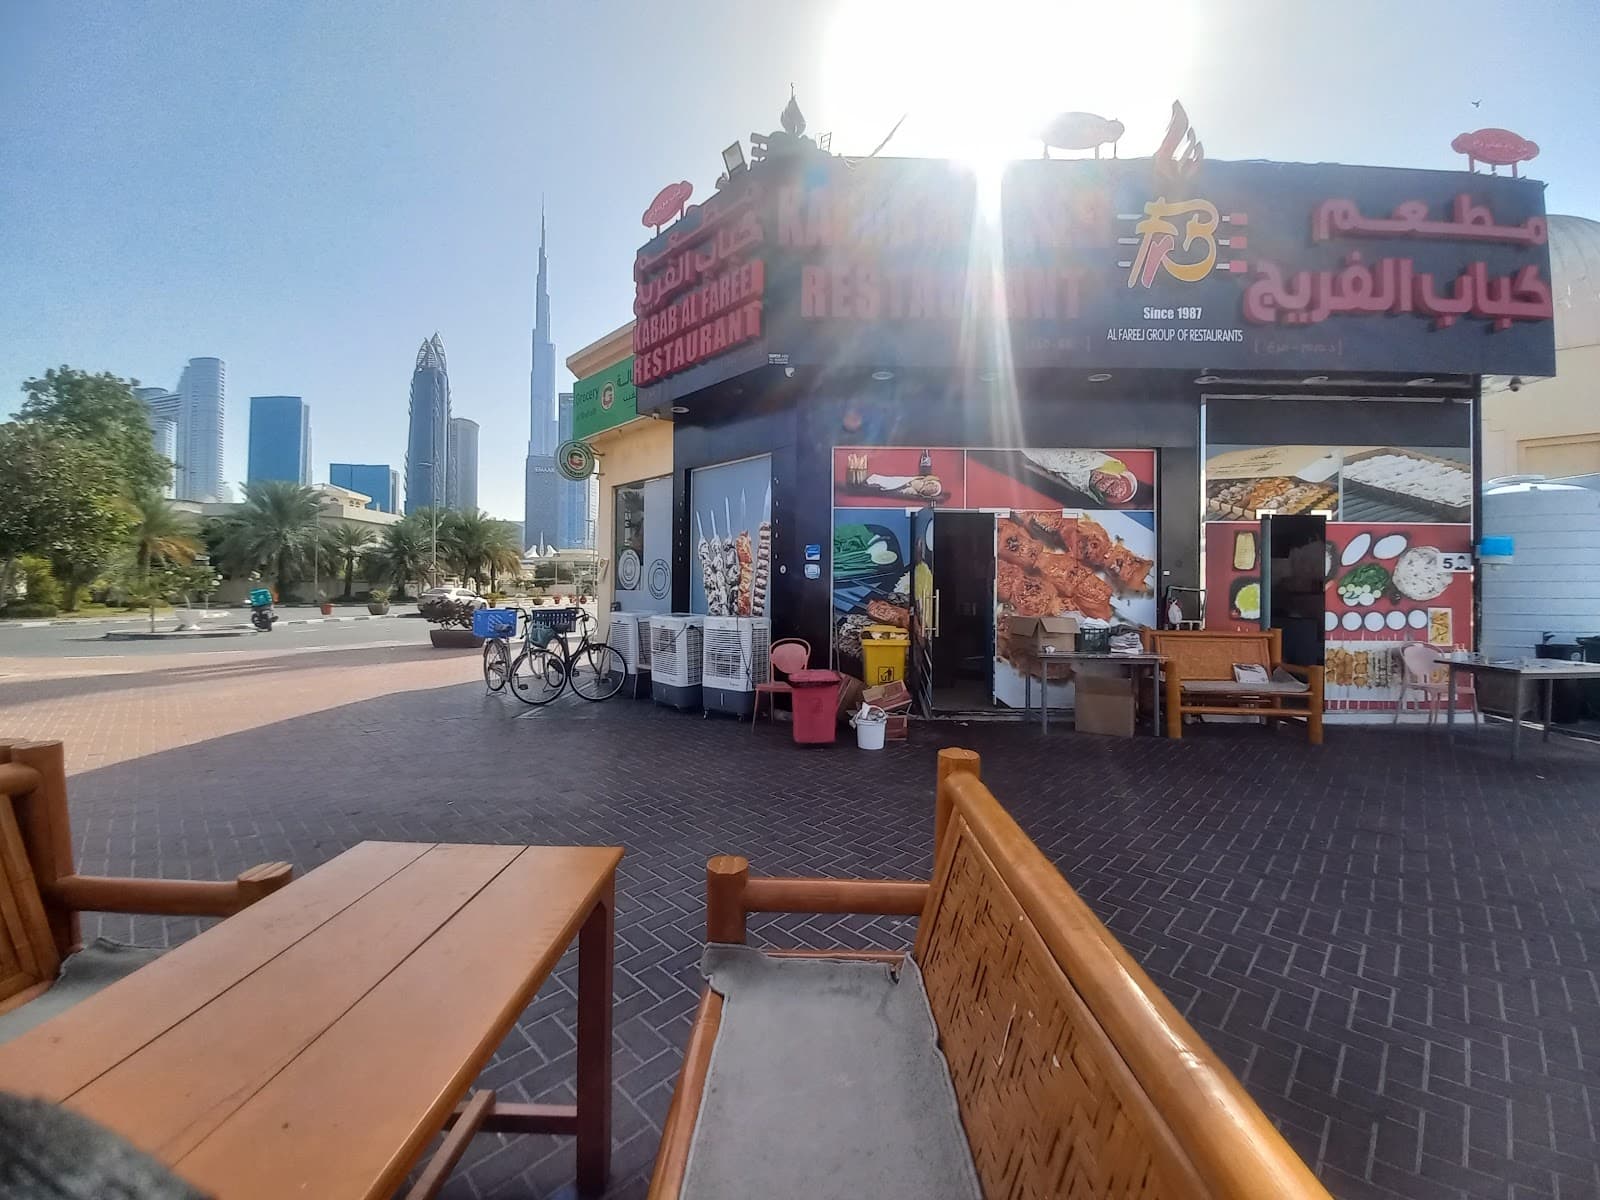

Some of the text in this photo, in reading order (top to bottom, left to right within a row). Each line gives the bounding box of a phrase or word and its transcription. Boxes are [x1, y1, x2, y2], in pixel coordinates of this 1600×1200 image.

[1312, 193, 1546, 246] مطعم
[800, 264, 1087, 319] RESTAUANT
[1143, 306, 1203, 320] Since 1987
[1242, 250, 1553, 330] كباب الفريج
[633, 301, 762, 387] RESTAURANT
[634, 307, 679, 353] KABAB
[682, 293, 698, 329] AL
[1107, 328, 1243, 343] AL FAREEJ GROUP OF RESTAURANTS
[1443, 557, 1453, 569] 5
